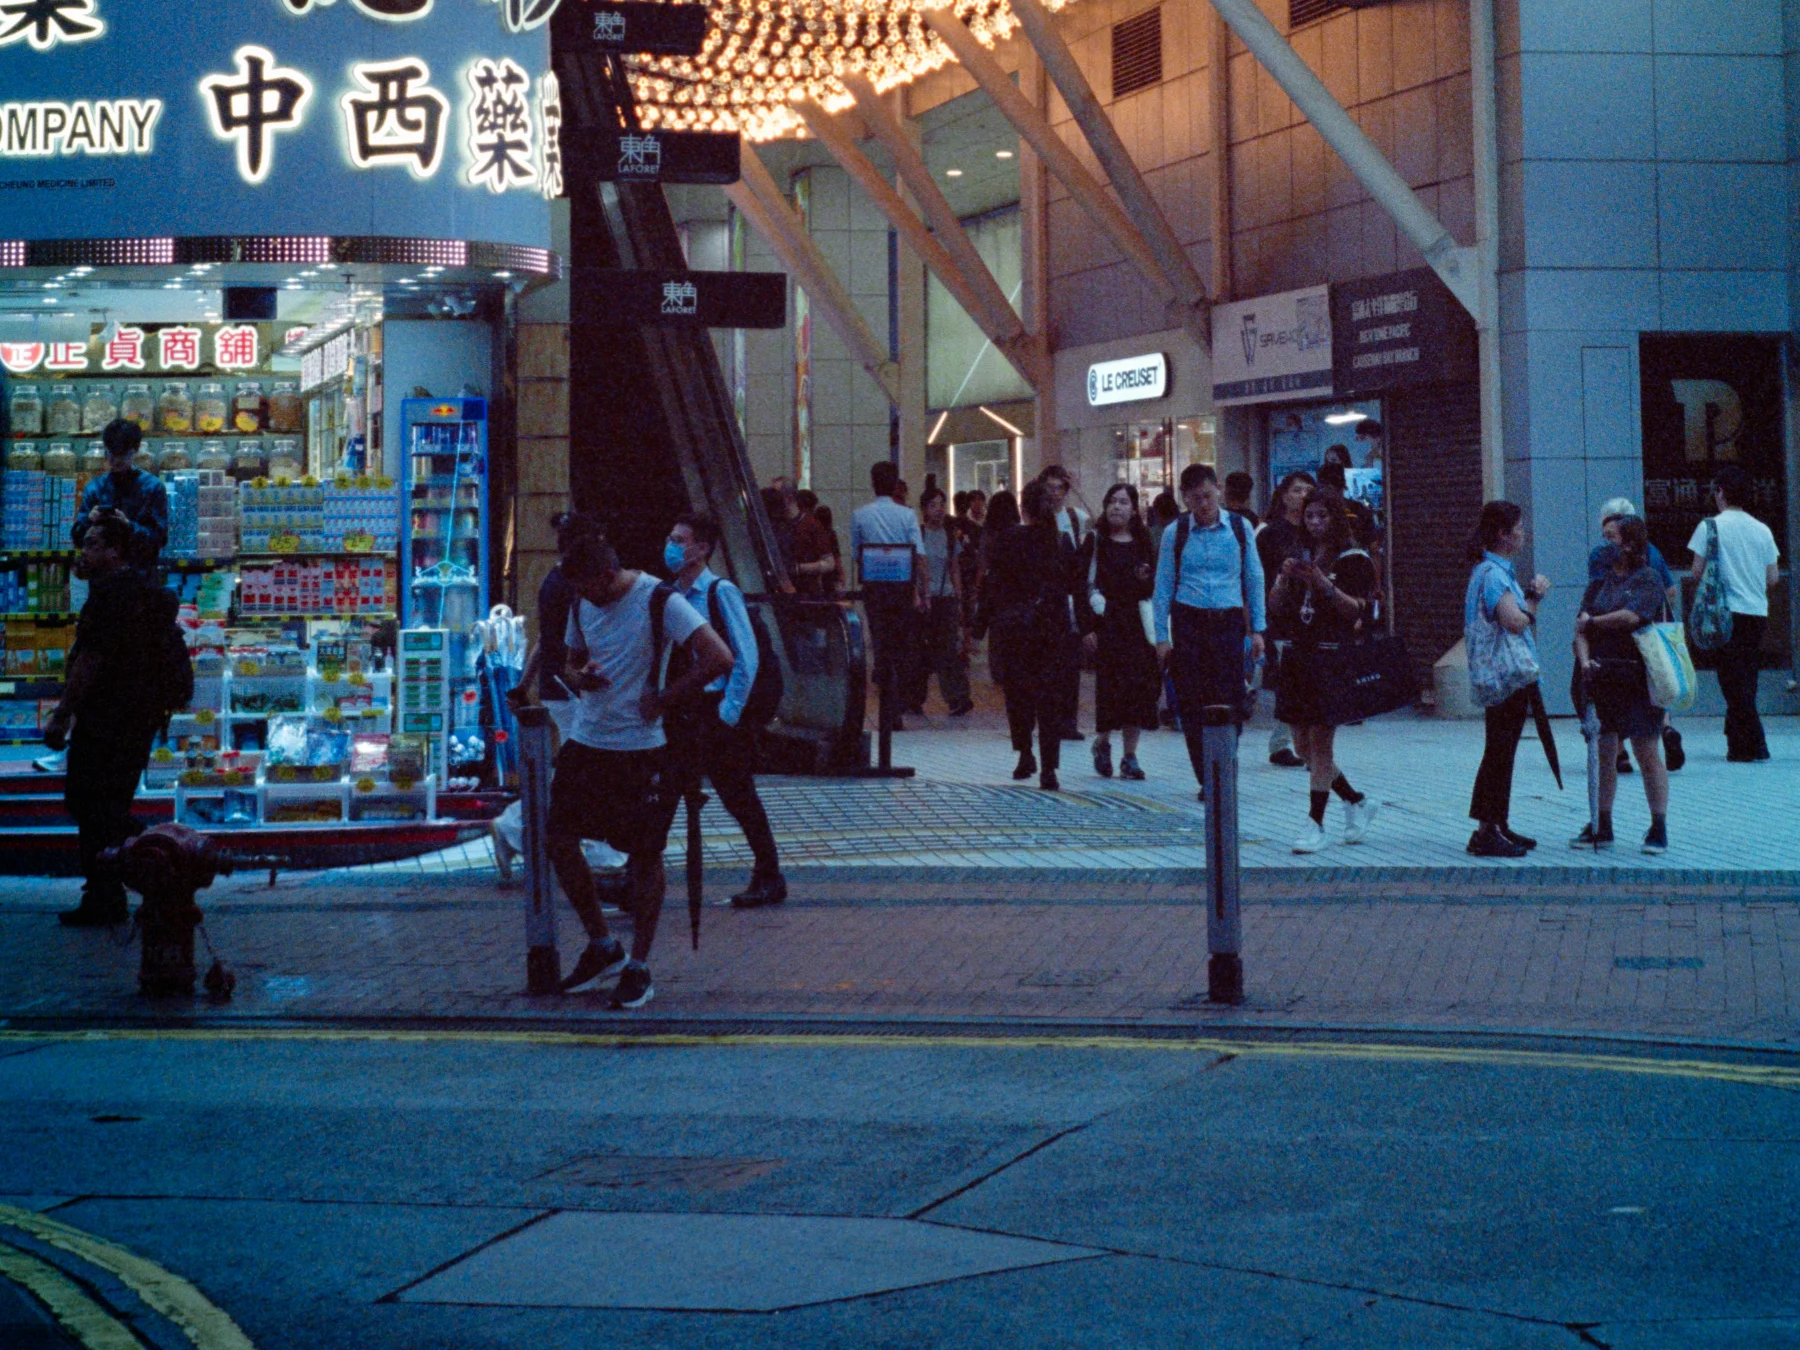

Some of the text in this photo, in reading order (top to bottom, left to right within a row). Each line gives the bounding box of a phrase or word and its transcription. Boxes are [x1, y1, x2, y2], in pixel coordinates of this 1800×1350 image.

[0, 102, 158, 152] MPANY
[618, 133, 660, 164] 東角
[618, 163, 660, 174] LAFORET
[661, 280, 697, 306] 東角
[661, 306, 697, 314] LAFORET
[1101, 366, 1159, 392] LE CREUSET
